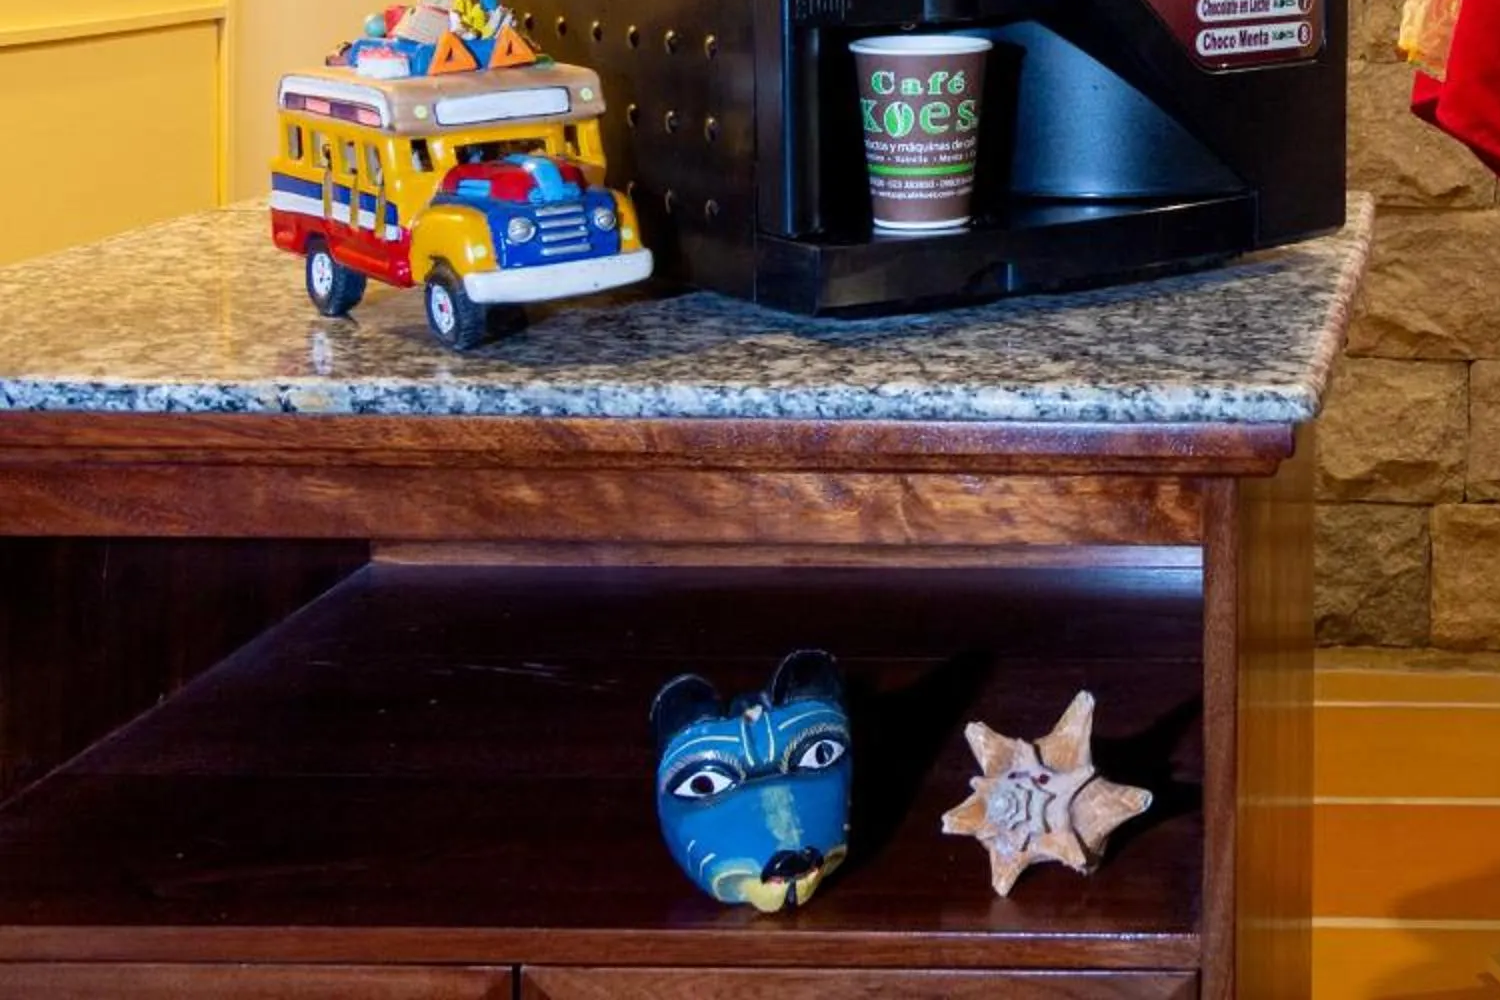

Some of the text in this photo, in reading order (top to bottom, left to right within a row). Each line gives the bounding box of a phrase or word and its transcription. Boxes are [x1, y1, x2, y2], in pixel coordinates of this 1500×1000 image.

[1203, 31, 1237, 51] Choco
[1239, 29, 1269, 47] Menta
[871, 70, 966, 96] Café
